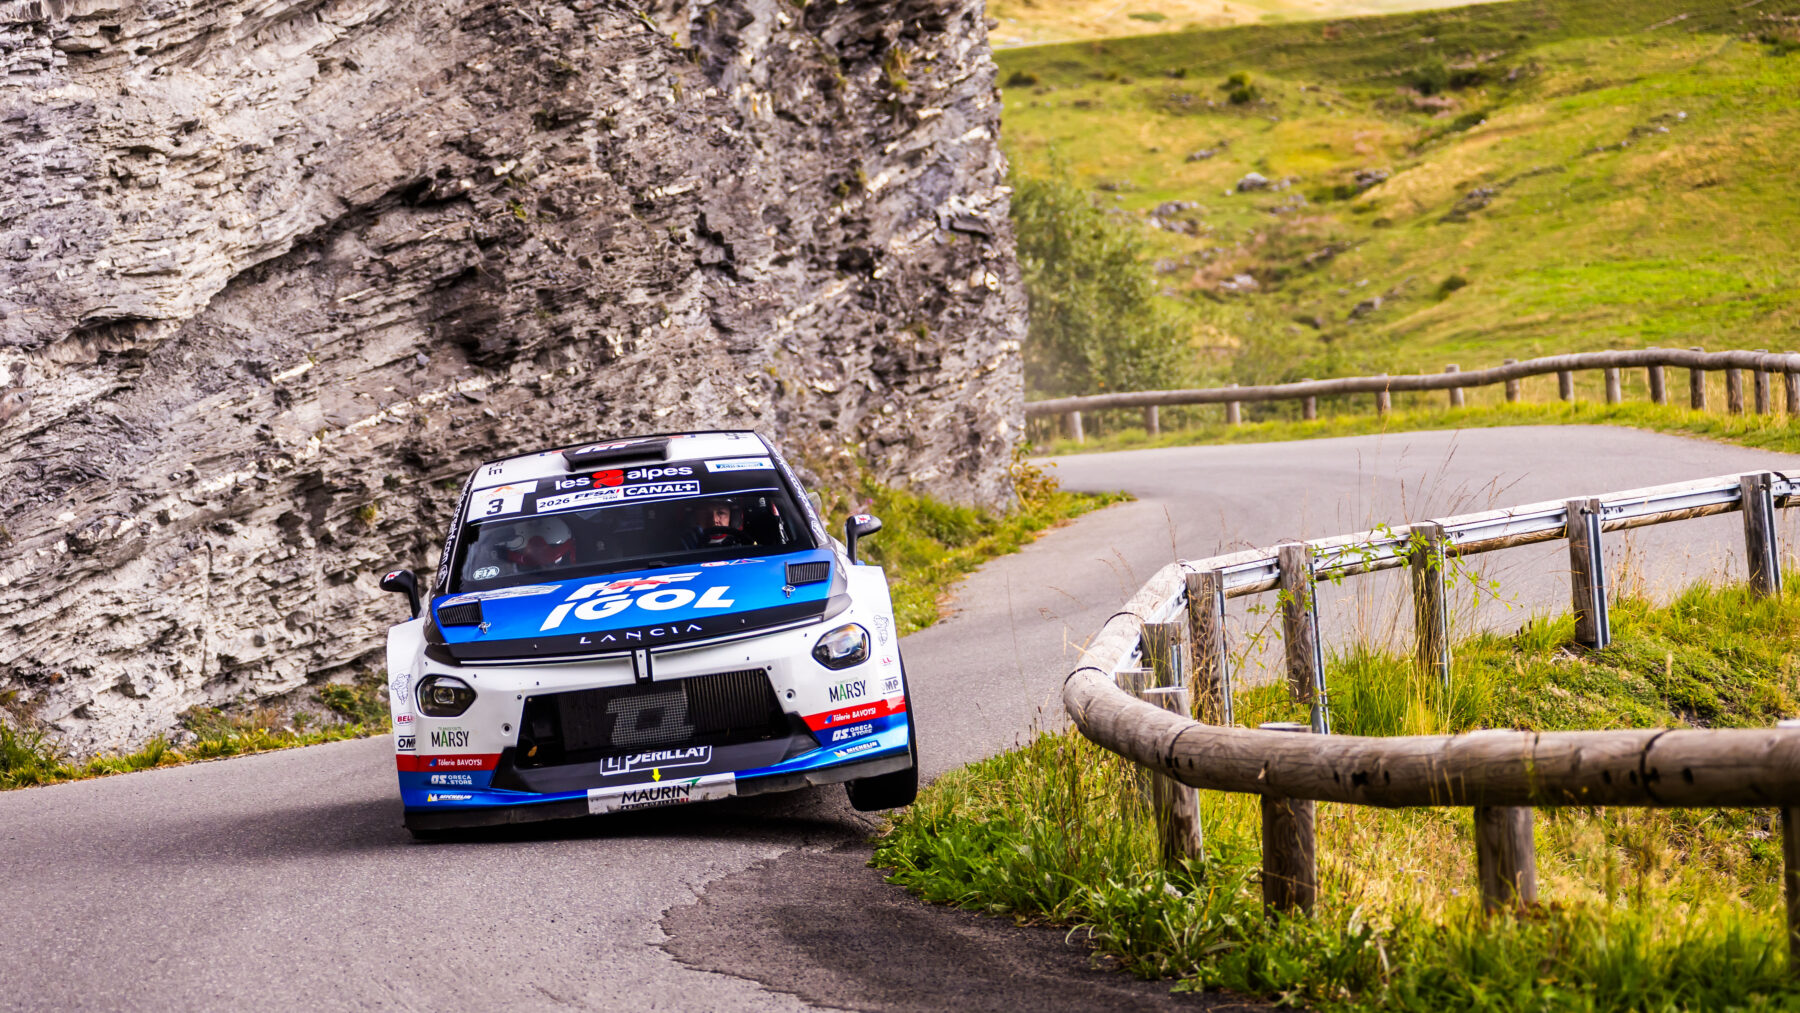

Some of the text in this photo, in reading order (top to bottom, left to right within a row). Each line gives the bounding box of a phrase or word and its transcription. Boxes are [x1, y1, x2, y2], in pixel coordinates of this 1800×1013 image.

[555, 477, 591, 491] les
[626, 467, 693, 481] alpes
[539, 498, 570, 508] 2026
[626, 483, 695, 495] CANAL+
[486, 498, 504, 515] 3
[474, 567, 499, 579] FIA
[540, 586, 735, 632] IGOL
[580, 624, 703, 644] LANCIA
[829, 679, 866, 703] MARSY
[881, 679, 899, 691] MP
[852, 707, 877, 719] BAVOYSI
[850, 724, 873, 733] ORECA
[431, 730, 470, 747] MARSY
[846, 741, 878, 754] MICHELIN
[457, 758, 483, 767] BAVOYSI
[621, 784, 690, 804] MAURIN
